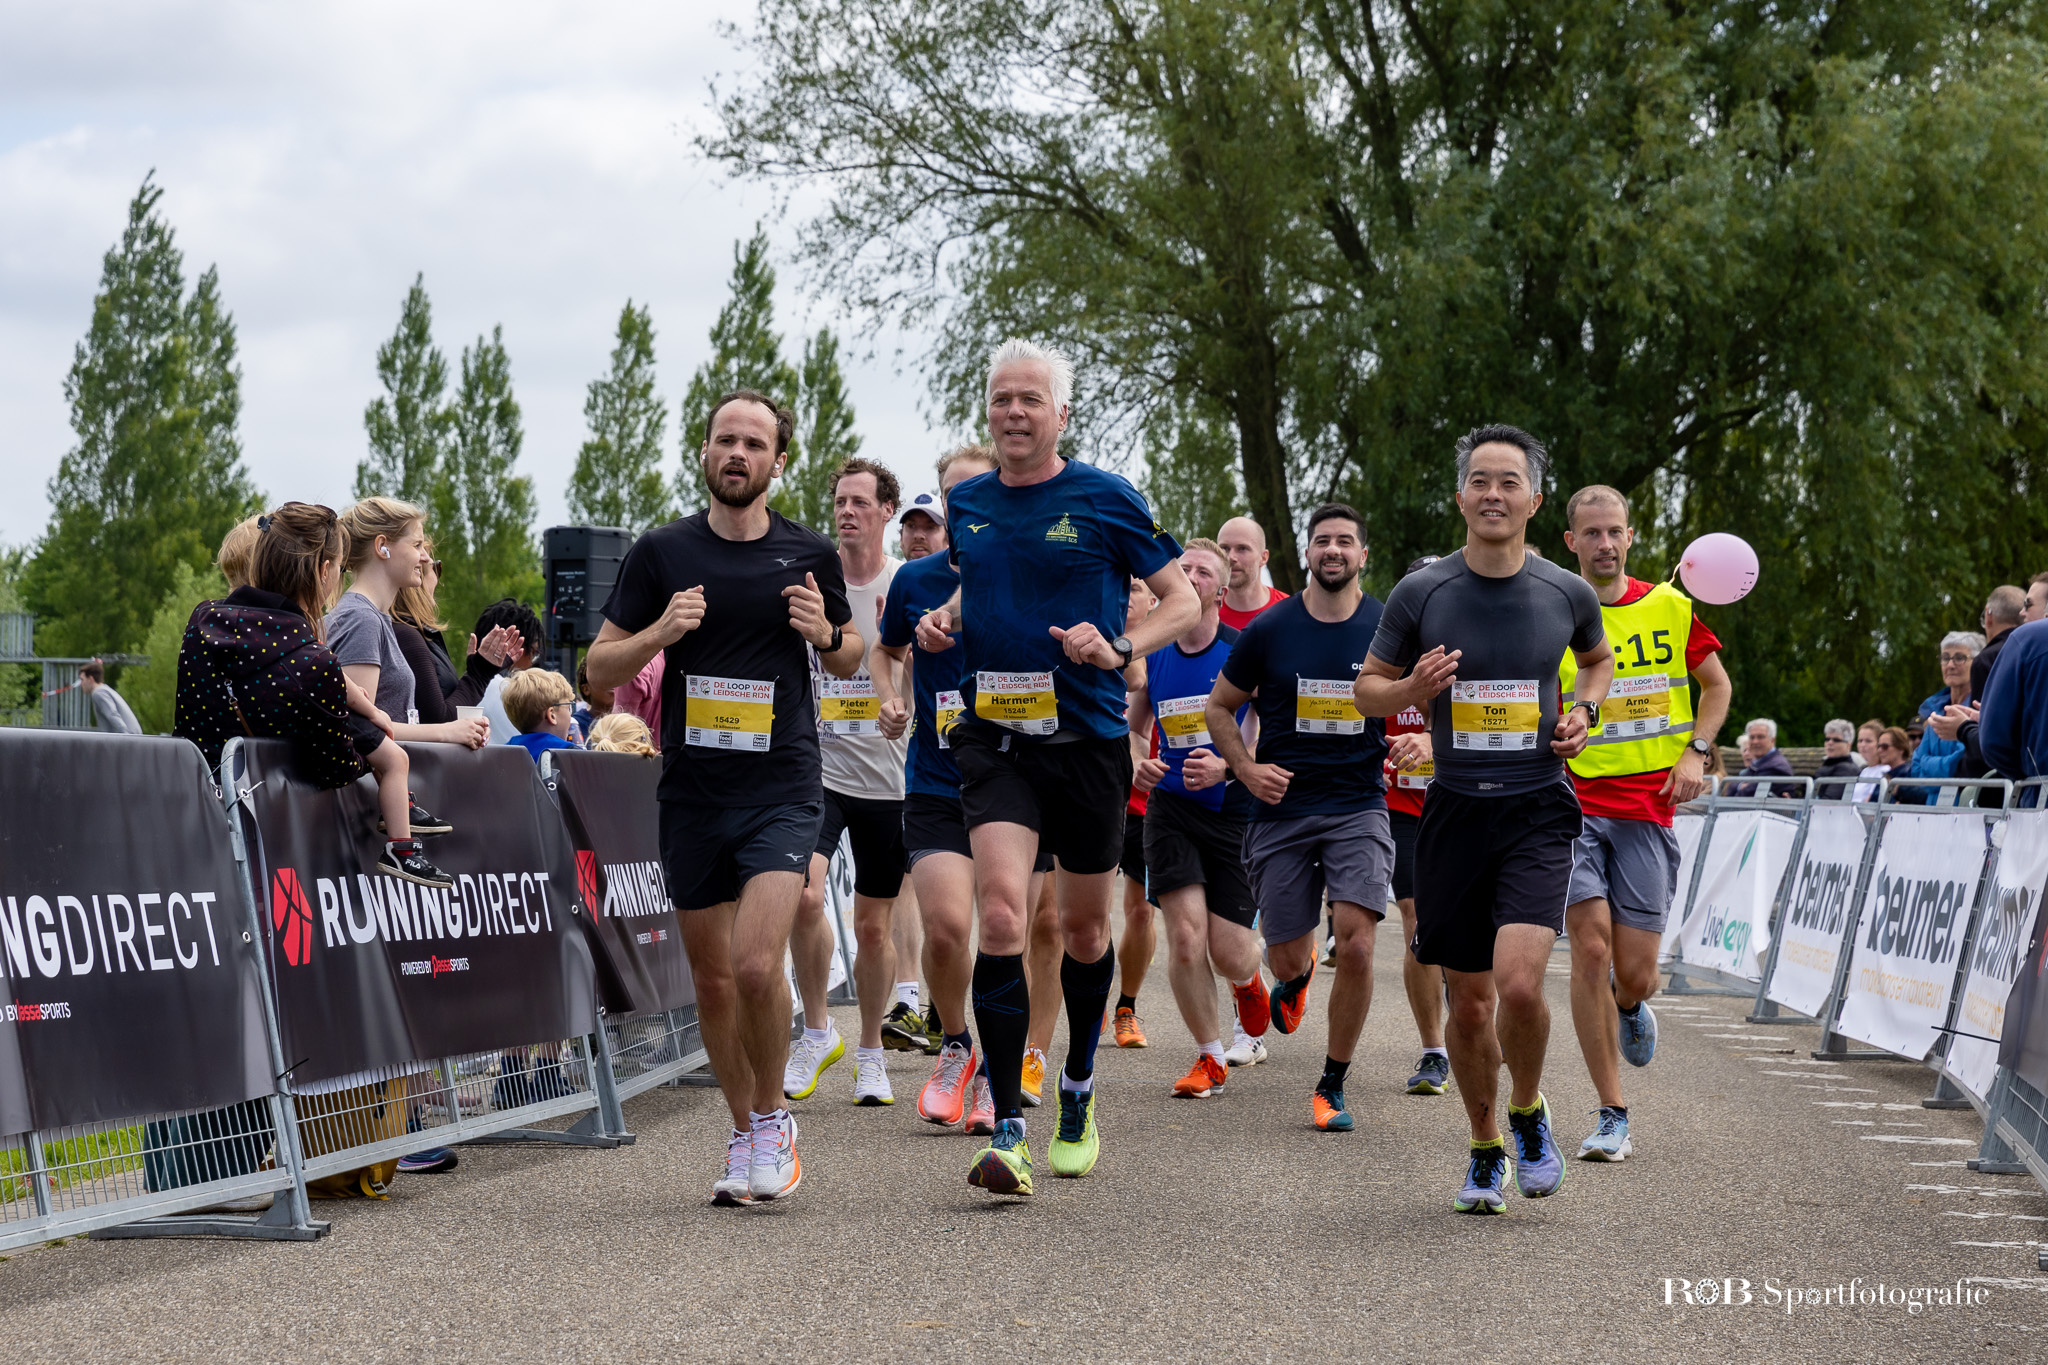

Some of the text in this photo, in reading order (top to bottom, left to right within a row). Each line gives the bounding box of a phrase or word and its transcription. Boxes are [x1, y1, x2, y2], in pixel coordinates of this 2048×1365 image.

[1031, 674, 1049, 682] VAN
[713, 689, 750, 698] LEIDSCHE
[1623, 685, 1653, 693] LEIDSCHE
[840, 700, 869, 708] Pieter
[991, 696, 1037, 705] Harmen
[1626, 698, 1649, 706] Arno
[1483, 706, 1506, 715] Ton
[1629, 707, 1648, 715] 15404
[714, 716, 739, 724] 15429
[405, 859, 420, 869] FILA
[317, 872, 552, 947] RUNNINGDIRECT
[0, 891, 220, 978] NGDIRECT
[401, 962, 425, 975] POWERED
[425, 961, 432, 973] BY
[5, 1004, 19, 1021] BY
